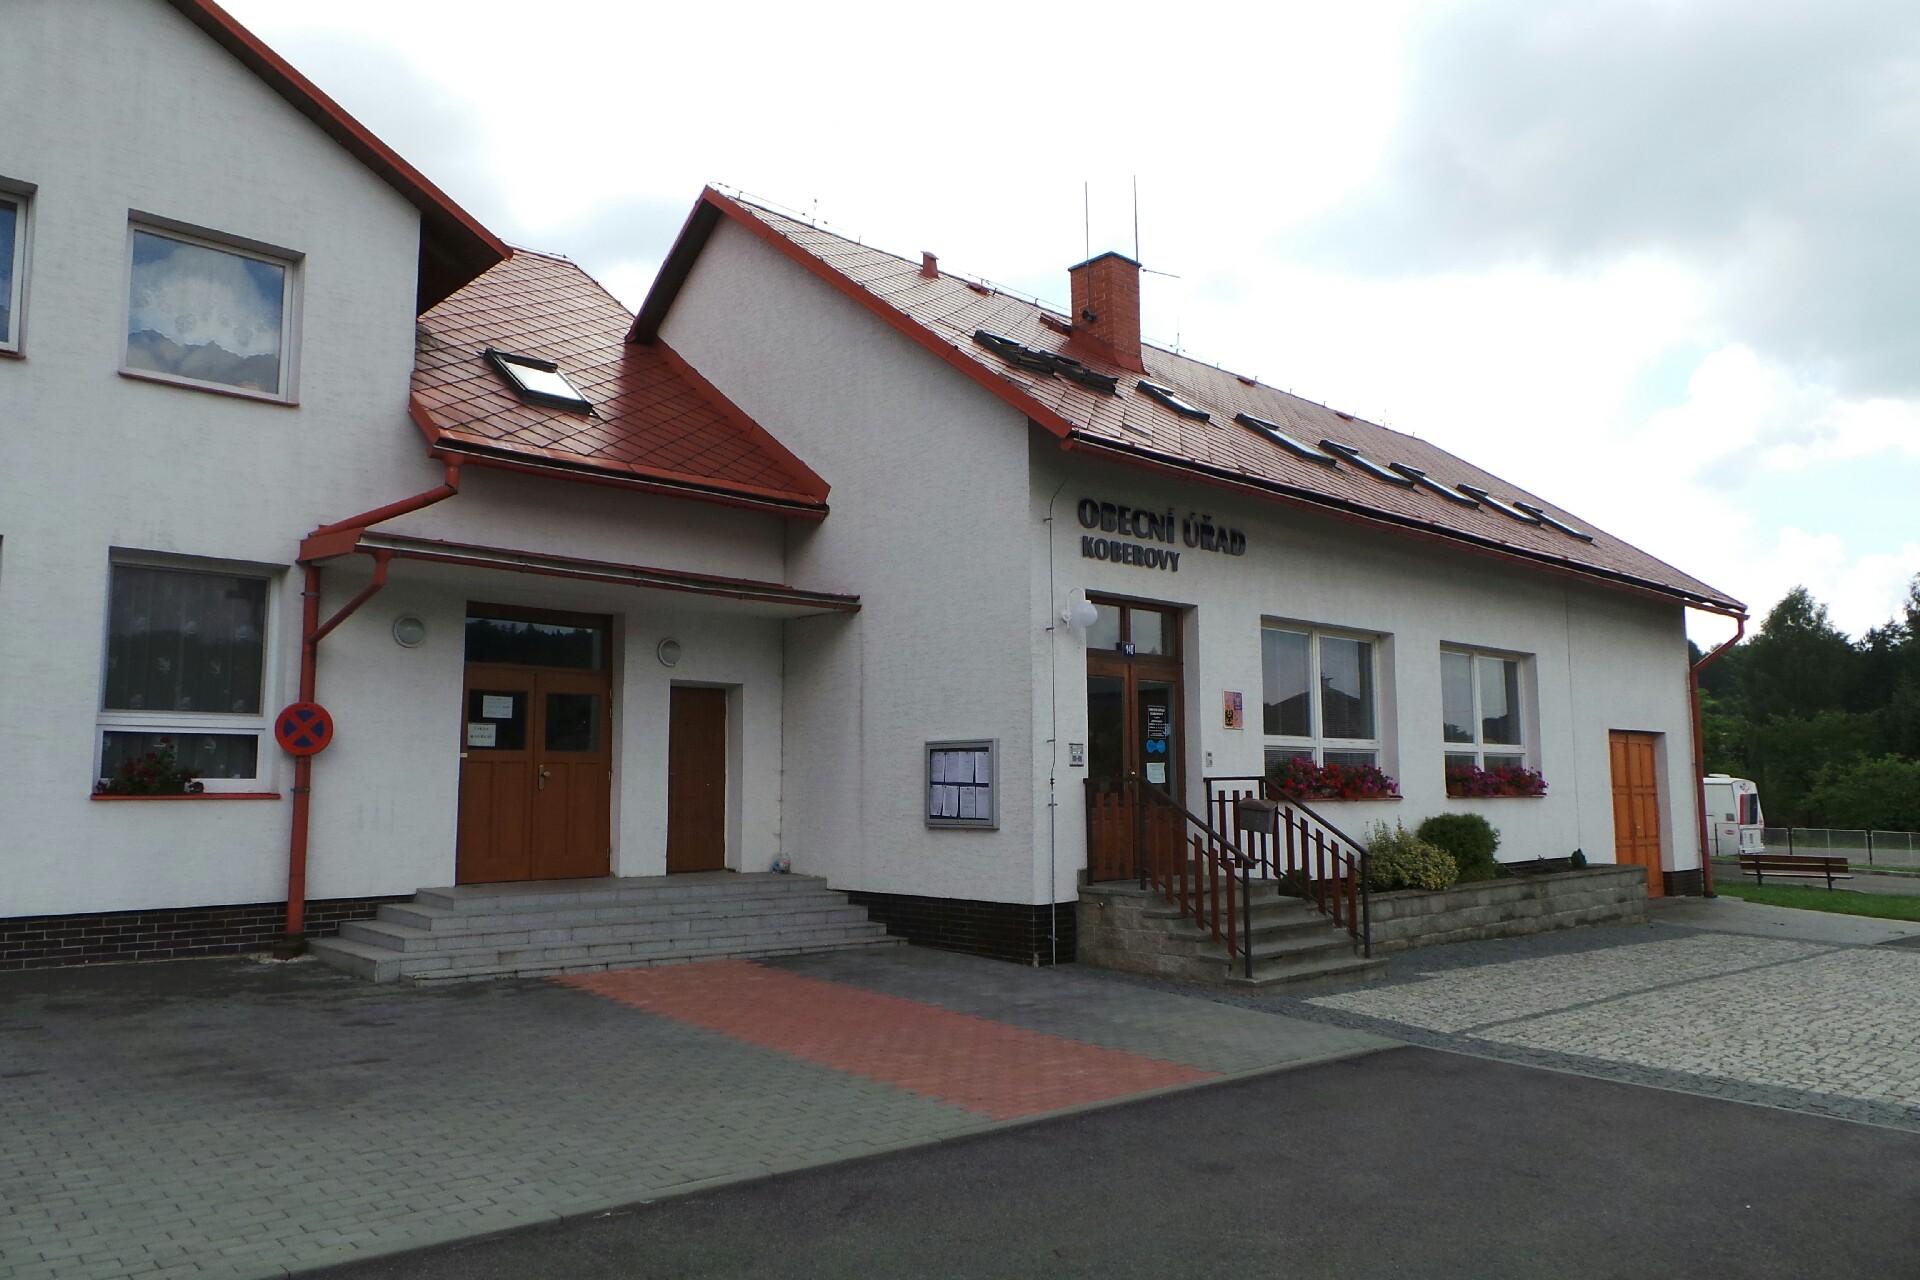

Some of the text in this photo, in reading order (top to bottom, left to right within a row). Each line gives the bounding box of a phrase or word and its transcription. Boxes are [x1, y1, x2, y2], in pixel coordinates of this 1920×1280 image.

[1078, 498, 1247, 556] OBECNÍ ÚŘAD
[1082, 535, 1180, 572] KOBEROVY
